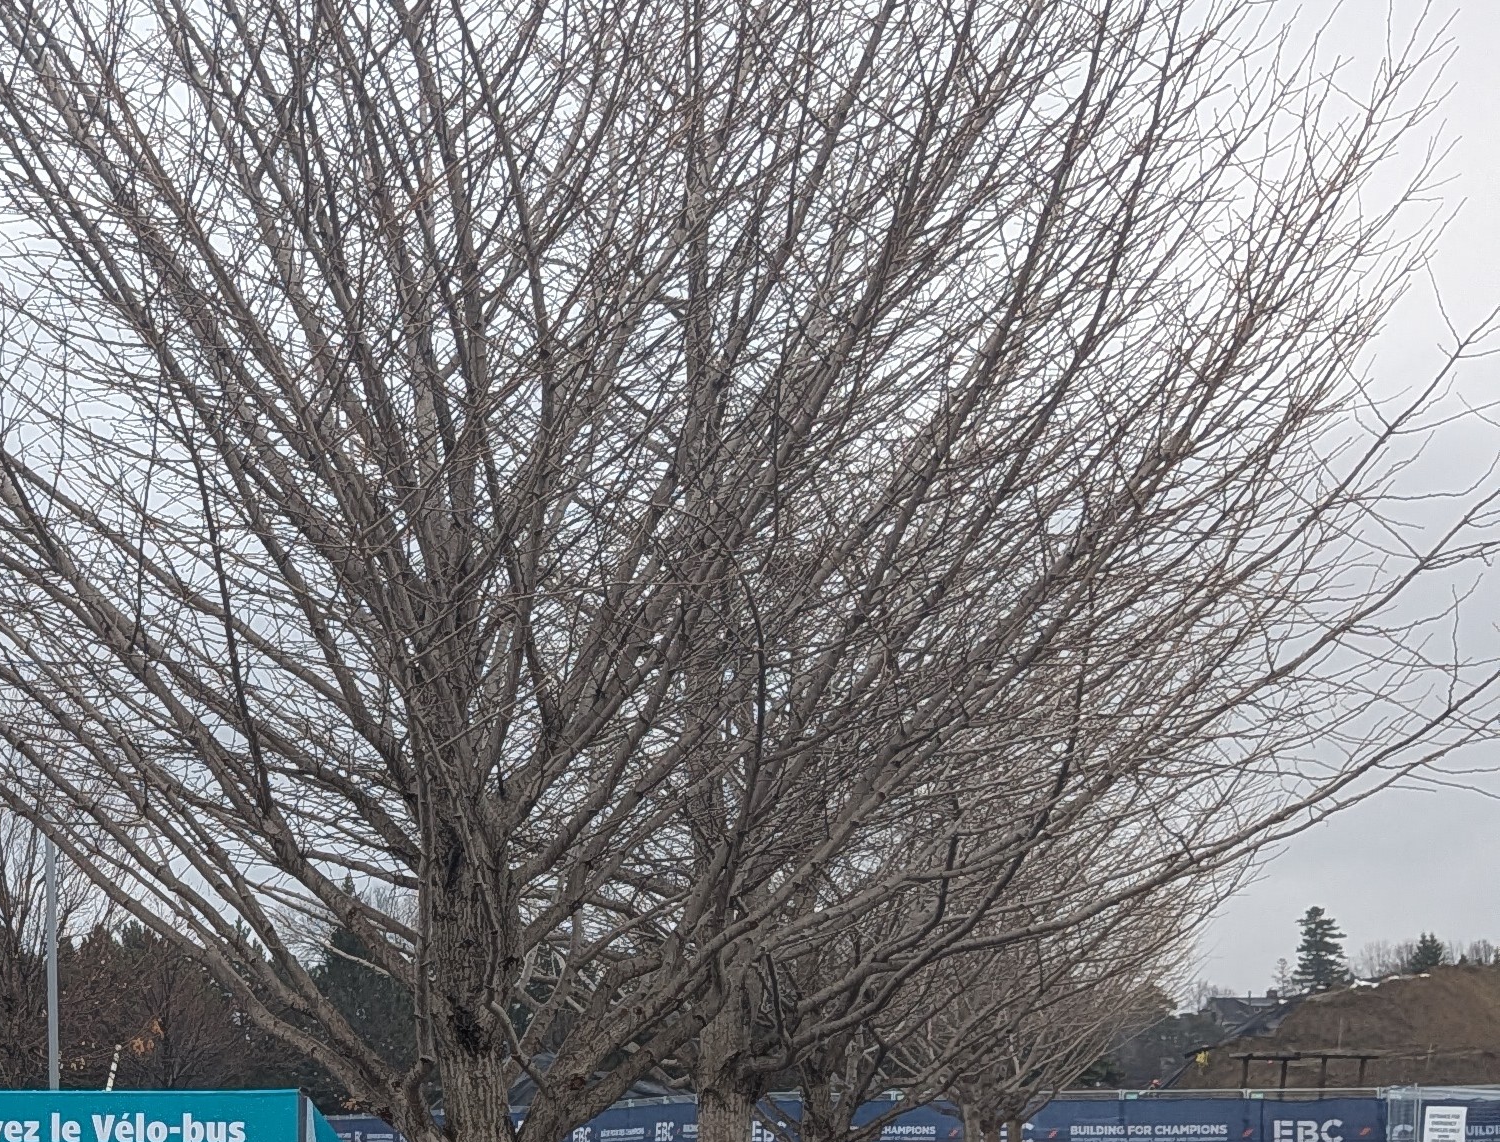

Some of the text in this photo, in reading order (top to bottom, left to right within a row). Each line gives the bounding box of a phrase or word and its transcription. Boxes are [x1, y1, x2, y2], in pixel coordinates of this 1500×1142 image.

[51, 1112, 81, 1142] le
[654, 1121, 674, 1142] EBC
[1070, 1124, 1228, 1136] BUILDING FOR CHAMPIONS
